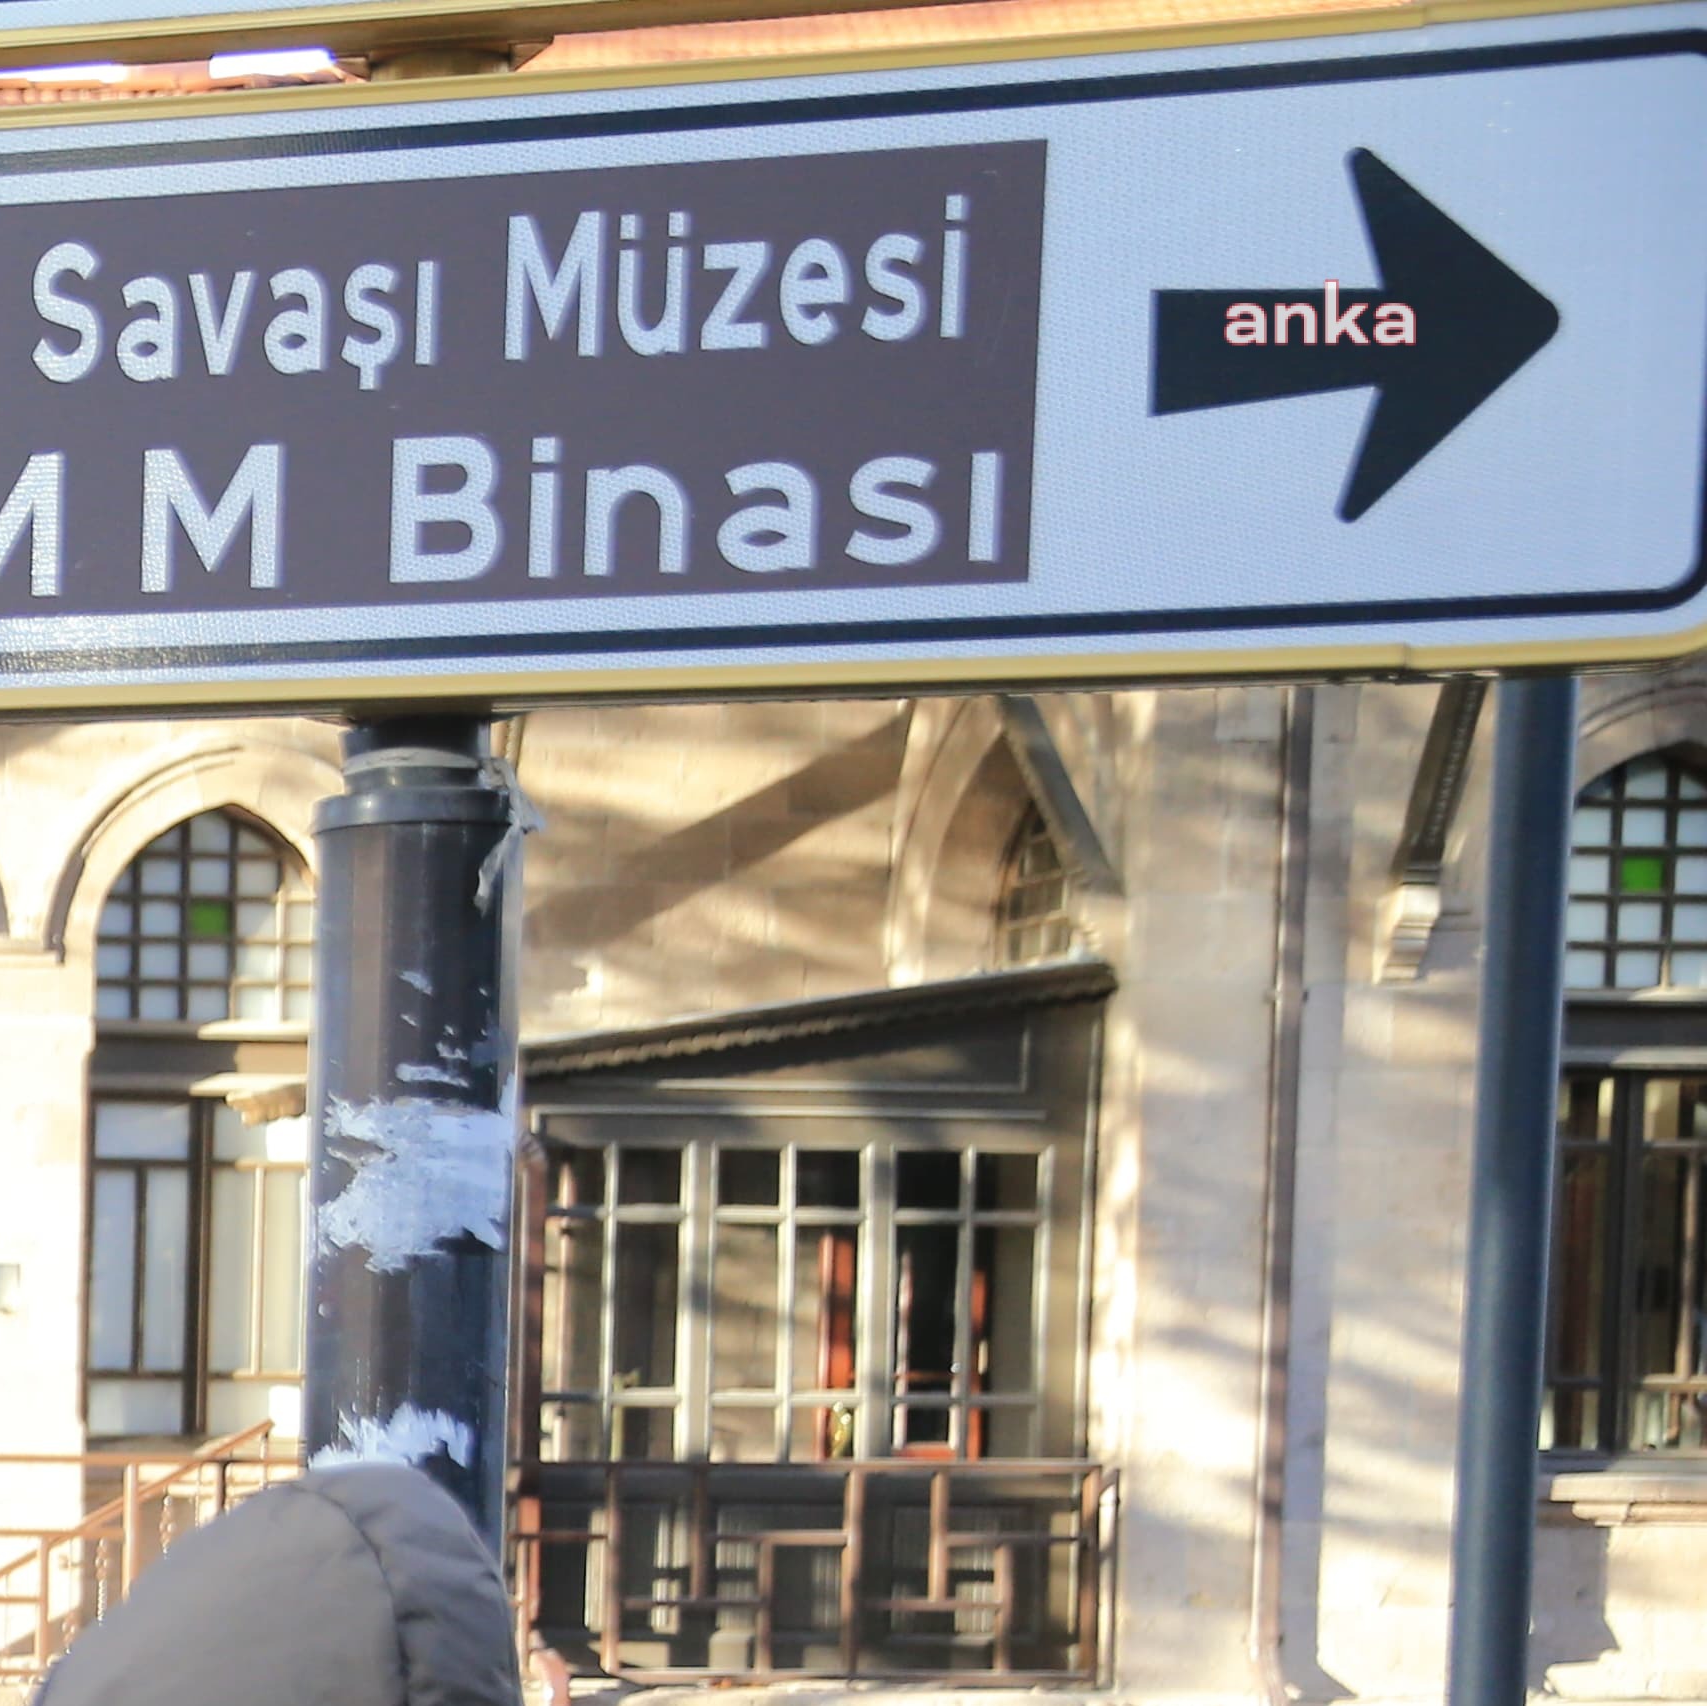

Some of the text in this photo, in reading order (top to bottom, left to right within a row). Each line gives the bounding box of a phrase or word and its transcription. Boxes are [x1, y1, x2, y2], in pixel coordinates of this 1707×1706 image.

[32, 242, 440, 391] Savaşı
[504, 194, 968, 361] Müzesi
[389, 435, 1002, 584] Binası
